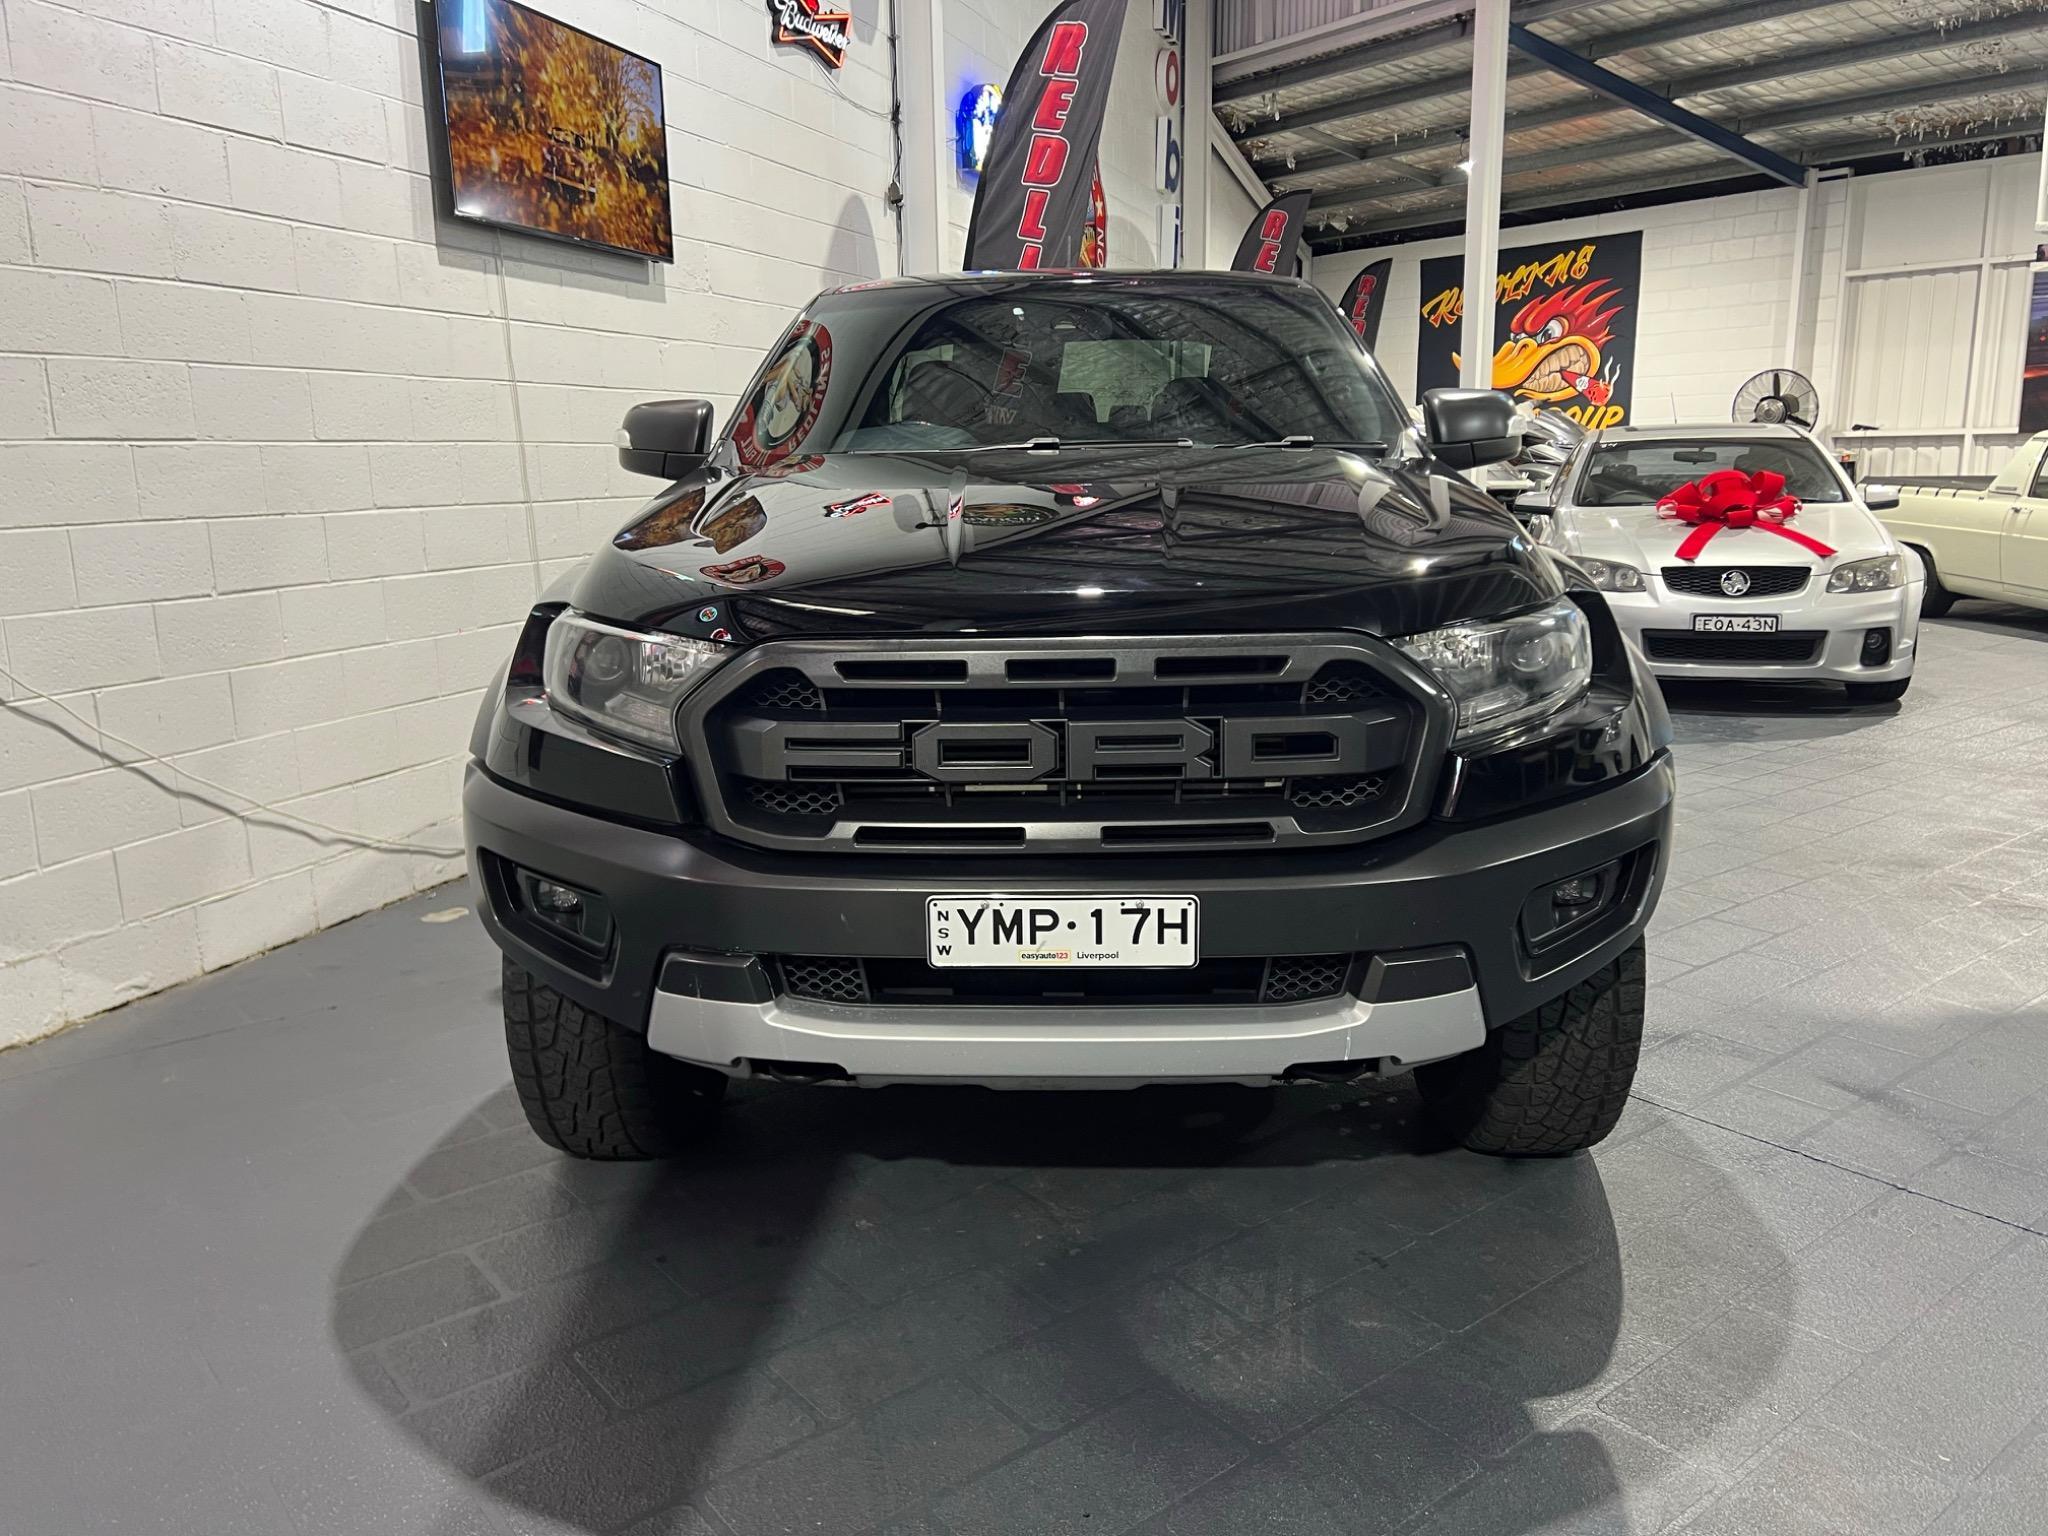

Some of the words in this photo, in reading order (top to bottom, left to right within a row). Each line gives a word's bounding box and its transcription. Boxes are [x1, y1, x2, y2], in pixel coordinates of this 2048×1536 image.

[774, 0, 848, 50] Budweiser
[736, 716, 1396, 782] FORD
[1021, 952, 1068, 960] easyauto123
[1077, 951, 1119, 961] Liverpool
